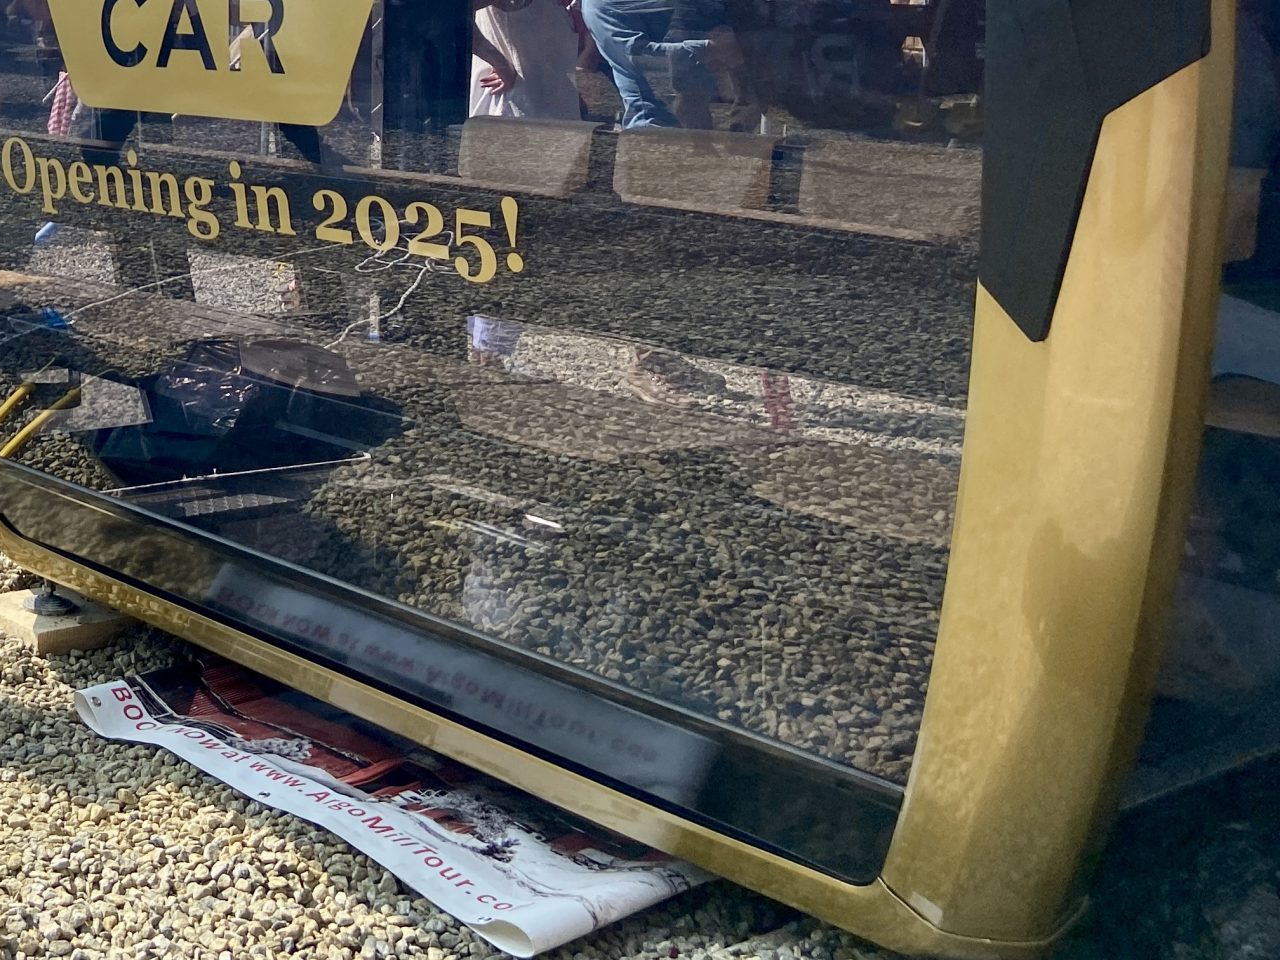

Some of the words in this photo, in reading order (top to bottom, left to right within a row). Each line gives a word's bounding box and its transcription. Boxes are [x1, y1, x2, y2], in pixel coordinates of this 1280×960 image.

[1, 136, 221, 240] Opening
[228, 160, 297, 236] in
[312, 189, 525, 283] 2025!
[220, 750, 251, 764] at
[249, 760, 516, 912] www.ArgoMillTour.co
